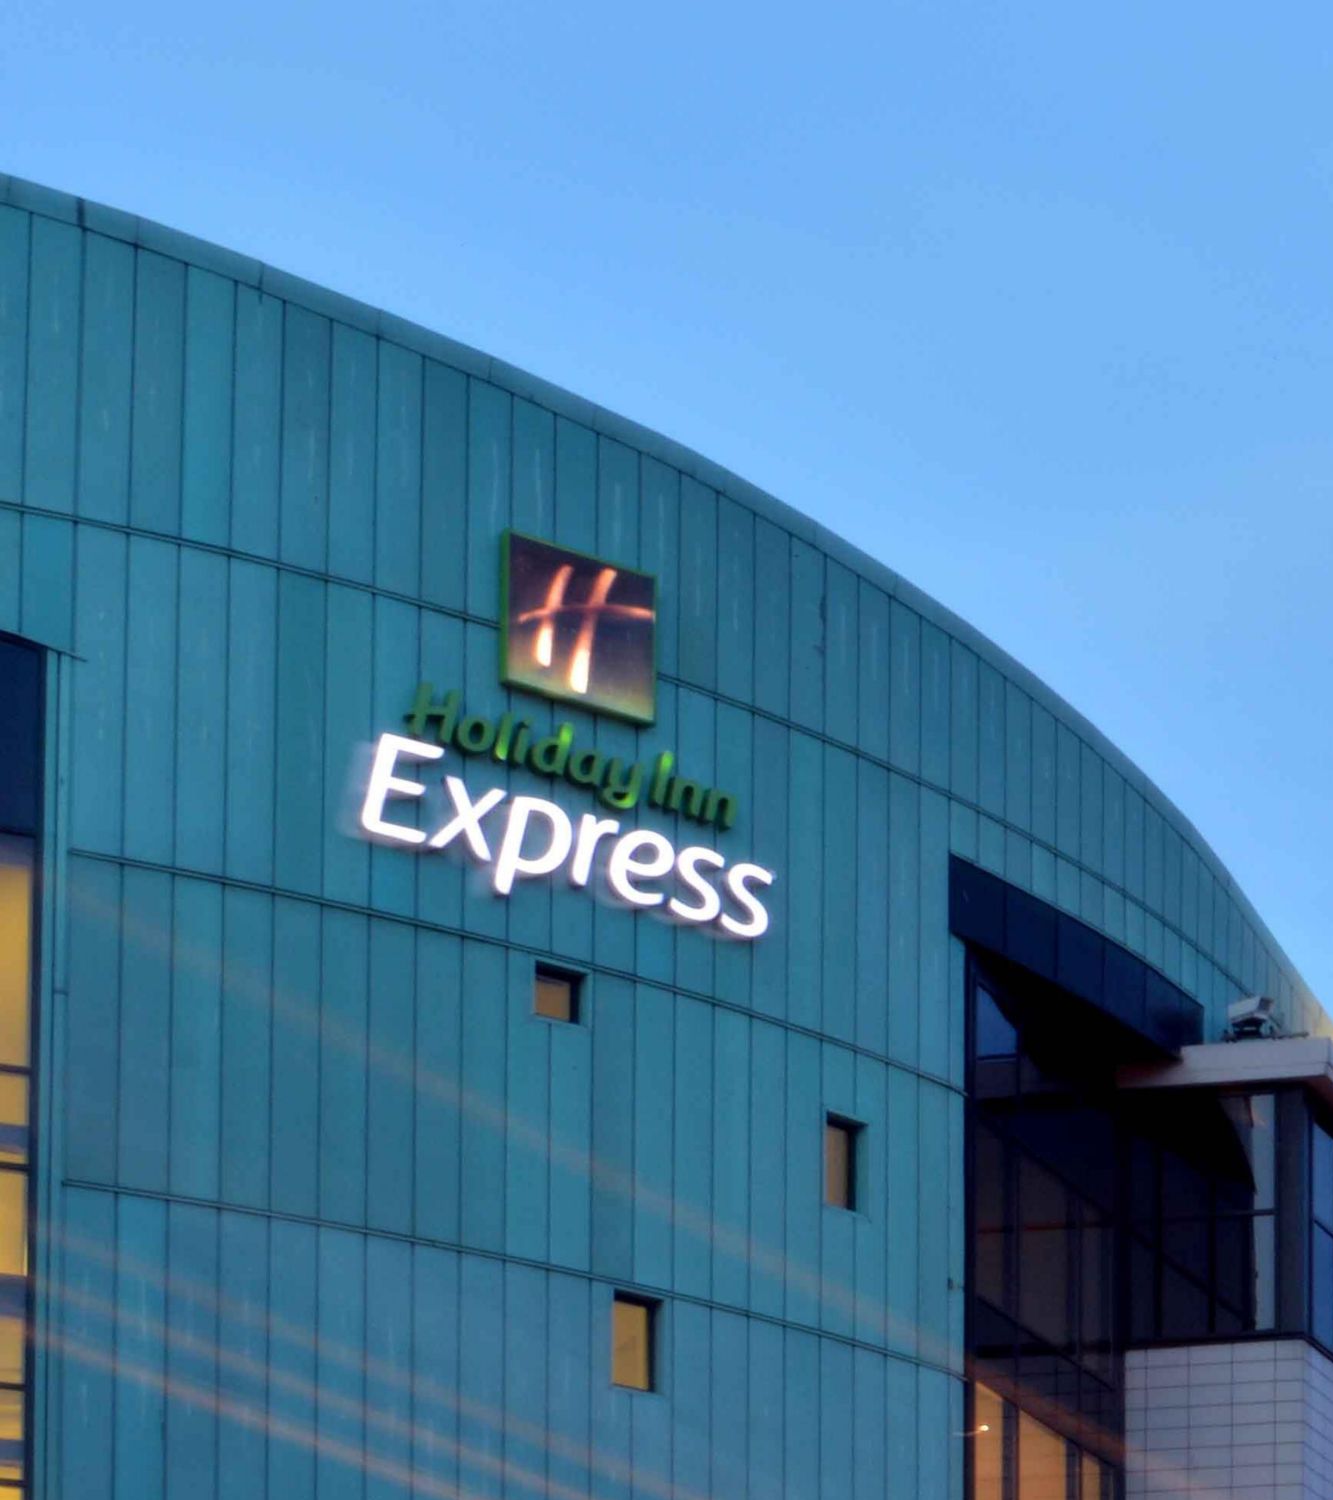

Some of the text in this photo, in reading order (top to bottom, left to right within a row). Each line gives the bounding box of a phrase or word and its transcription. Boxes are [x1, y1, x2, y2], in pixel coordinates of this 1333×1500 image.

[361, 732, 776, 938] Express
[404, 681, 738, 831] Holiday Inn
